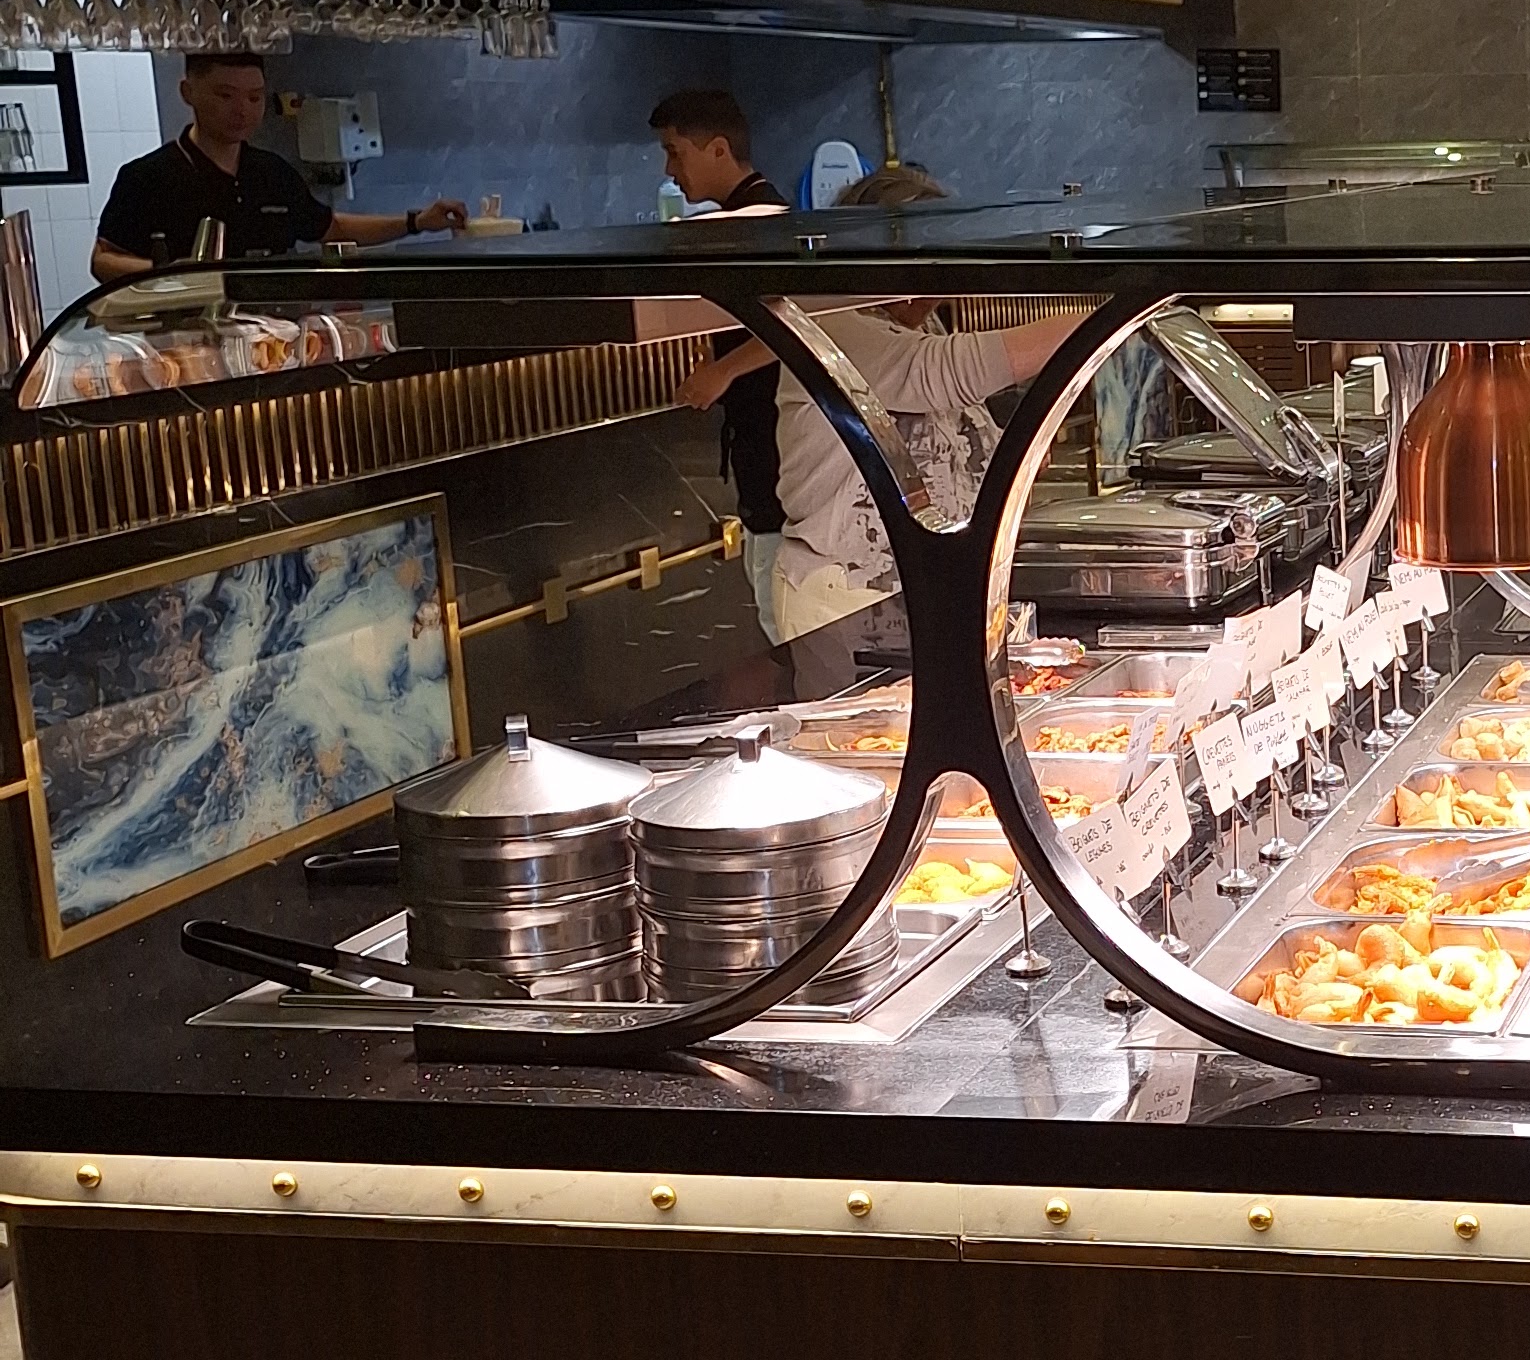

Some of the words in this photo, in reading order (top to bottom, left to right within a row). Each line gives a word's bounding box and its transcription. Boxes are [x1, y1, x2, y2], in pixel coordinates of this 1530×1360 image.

[1245, 711, 1286, 738] NUGGETS
[1253, 741, 1264, 755] DE
[1100, 818, 1113, 835] DE
